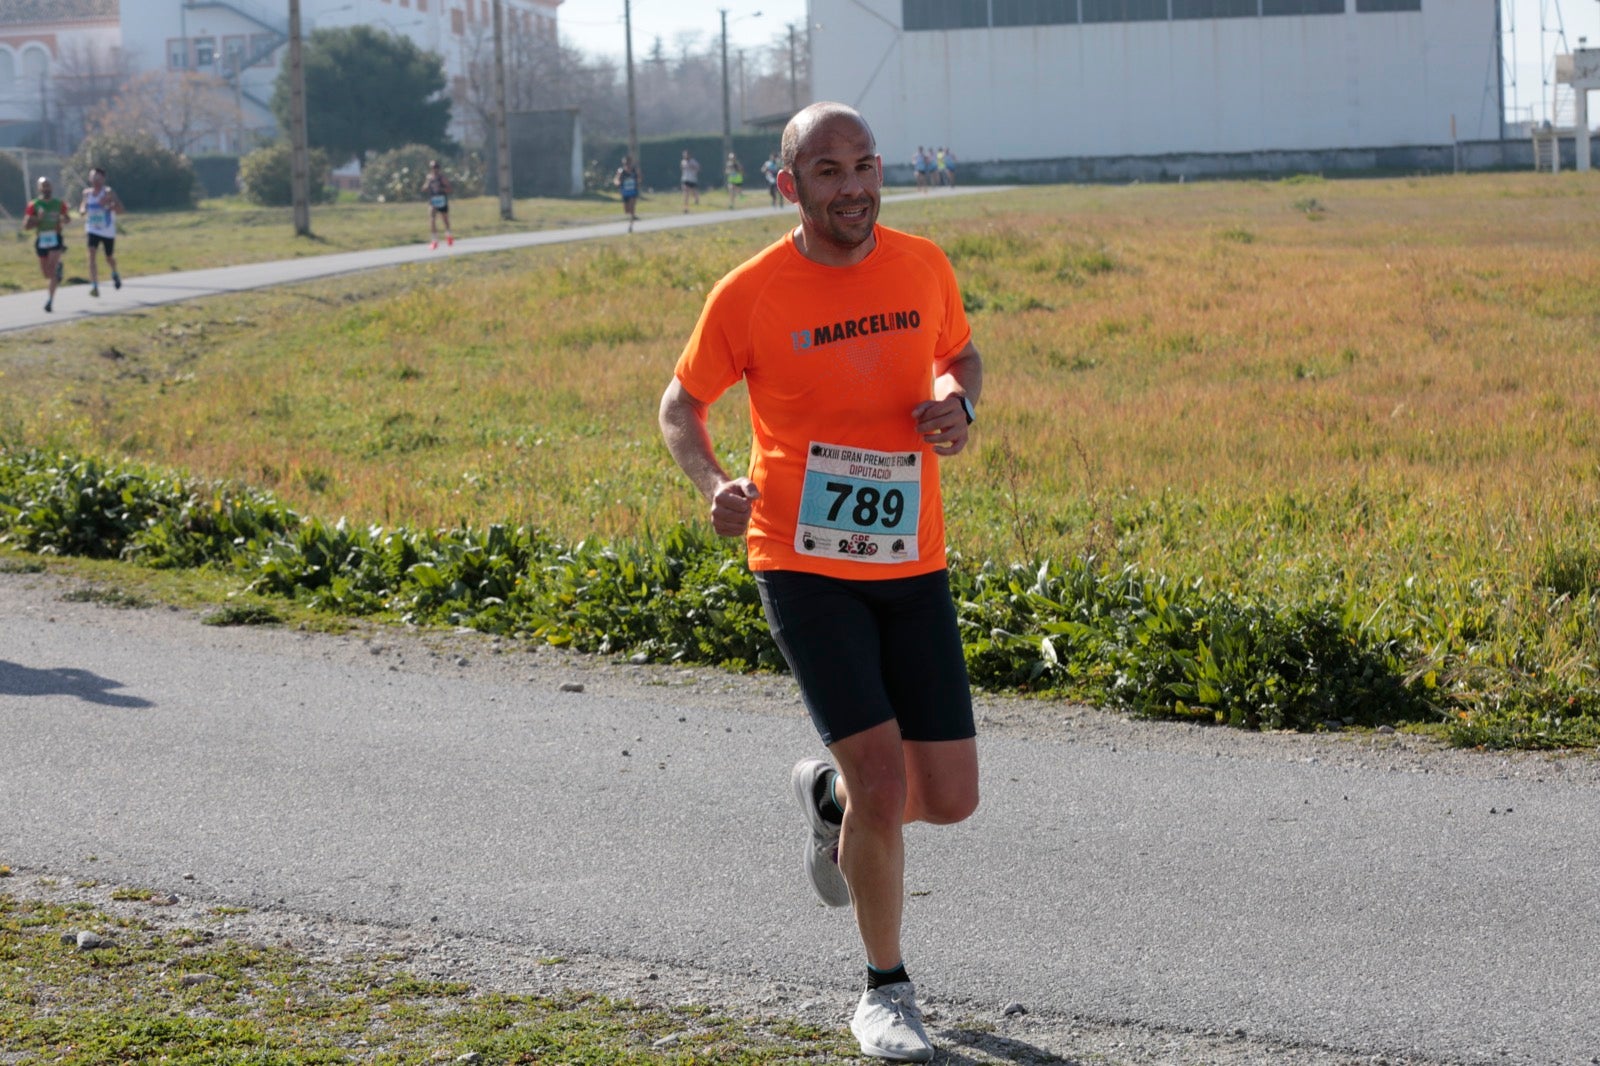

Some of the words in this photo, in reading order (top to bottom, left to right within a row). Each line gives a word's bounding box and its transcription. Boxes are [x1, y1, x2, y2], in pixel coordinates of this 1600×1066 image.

[814, 310, 920, 346] MARCELINO
[841, 450, 861, 463] GRAN
[864, 453, 891, 467] PREMIO
[897, 456, 916, 467] FON
[826, 481, 904, 528] 789
